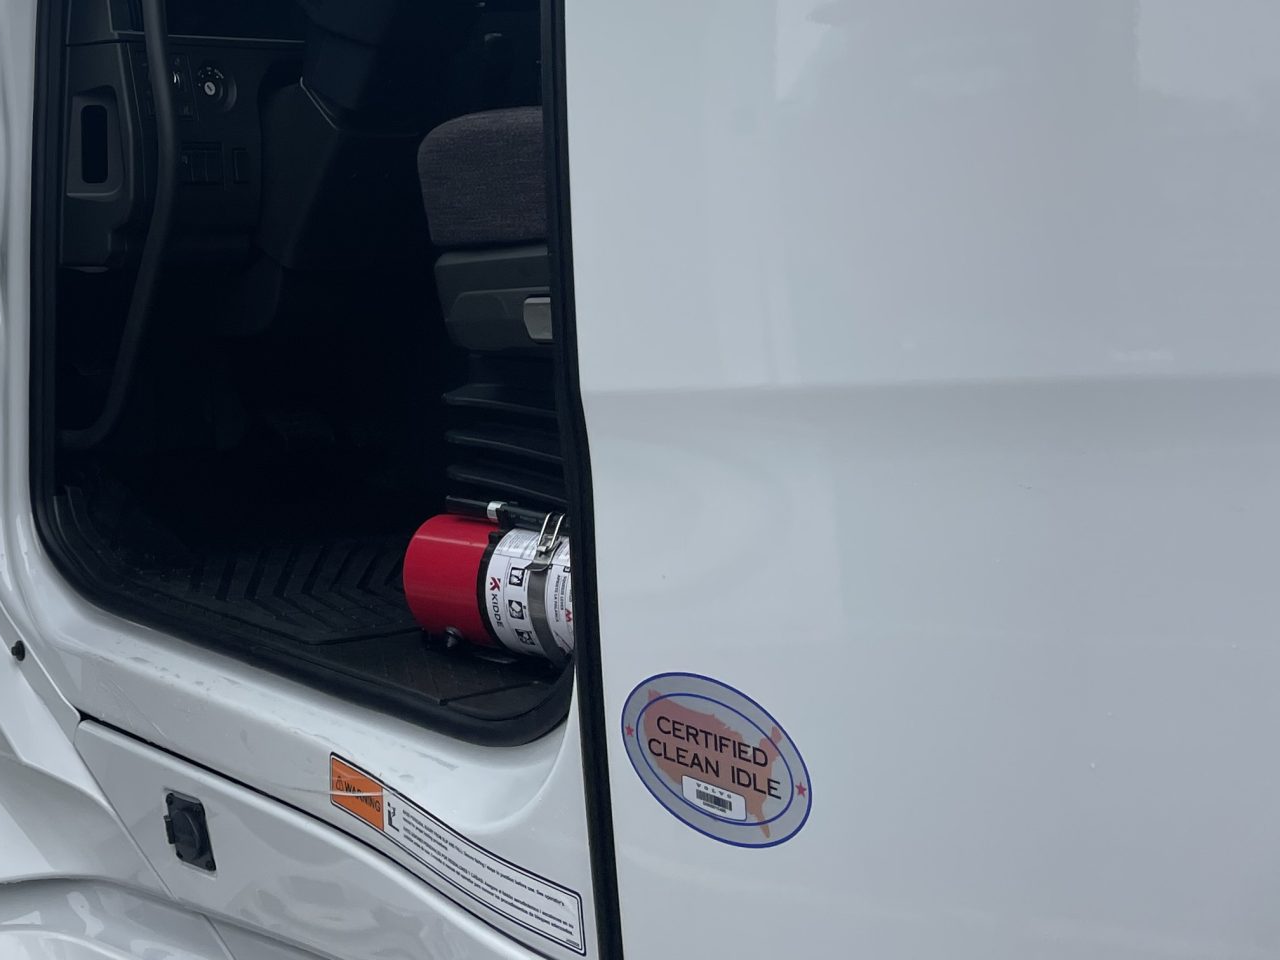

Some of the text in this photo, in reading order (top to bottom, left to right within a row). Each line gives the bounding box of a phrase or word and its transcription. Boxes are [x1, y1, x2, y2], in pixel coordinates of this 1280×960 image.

[491, 593, 504, 628] KIDDE
[656, 715, 769, 768] CERTIFIED
[647, 737, 782, 800] CLEAN IDLE
[344, 781, 381, 813] WARNING
[695, 782, 734, 799] VOLVO
